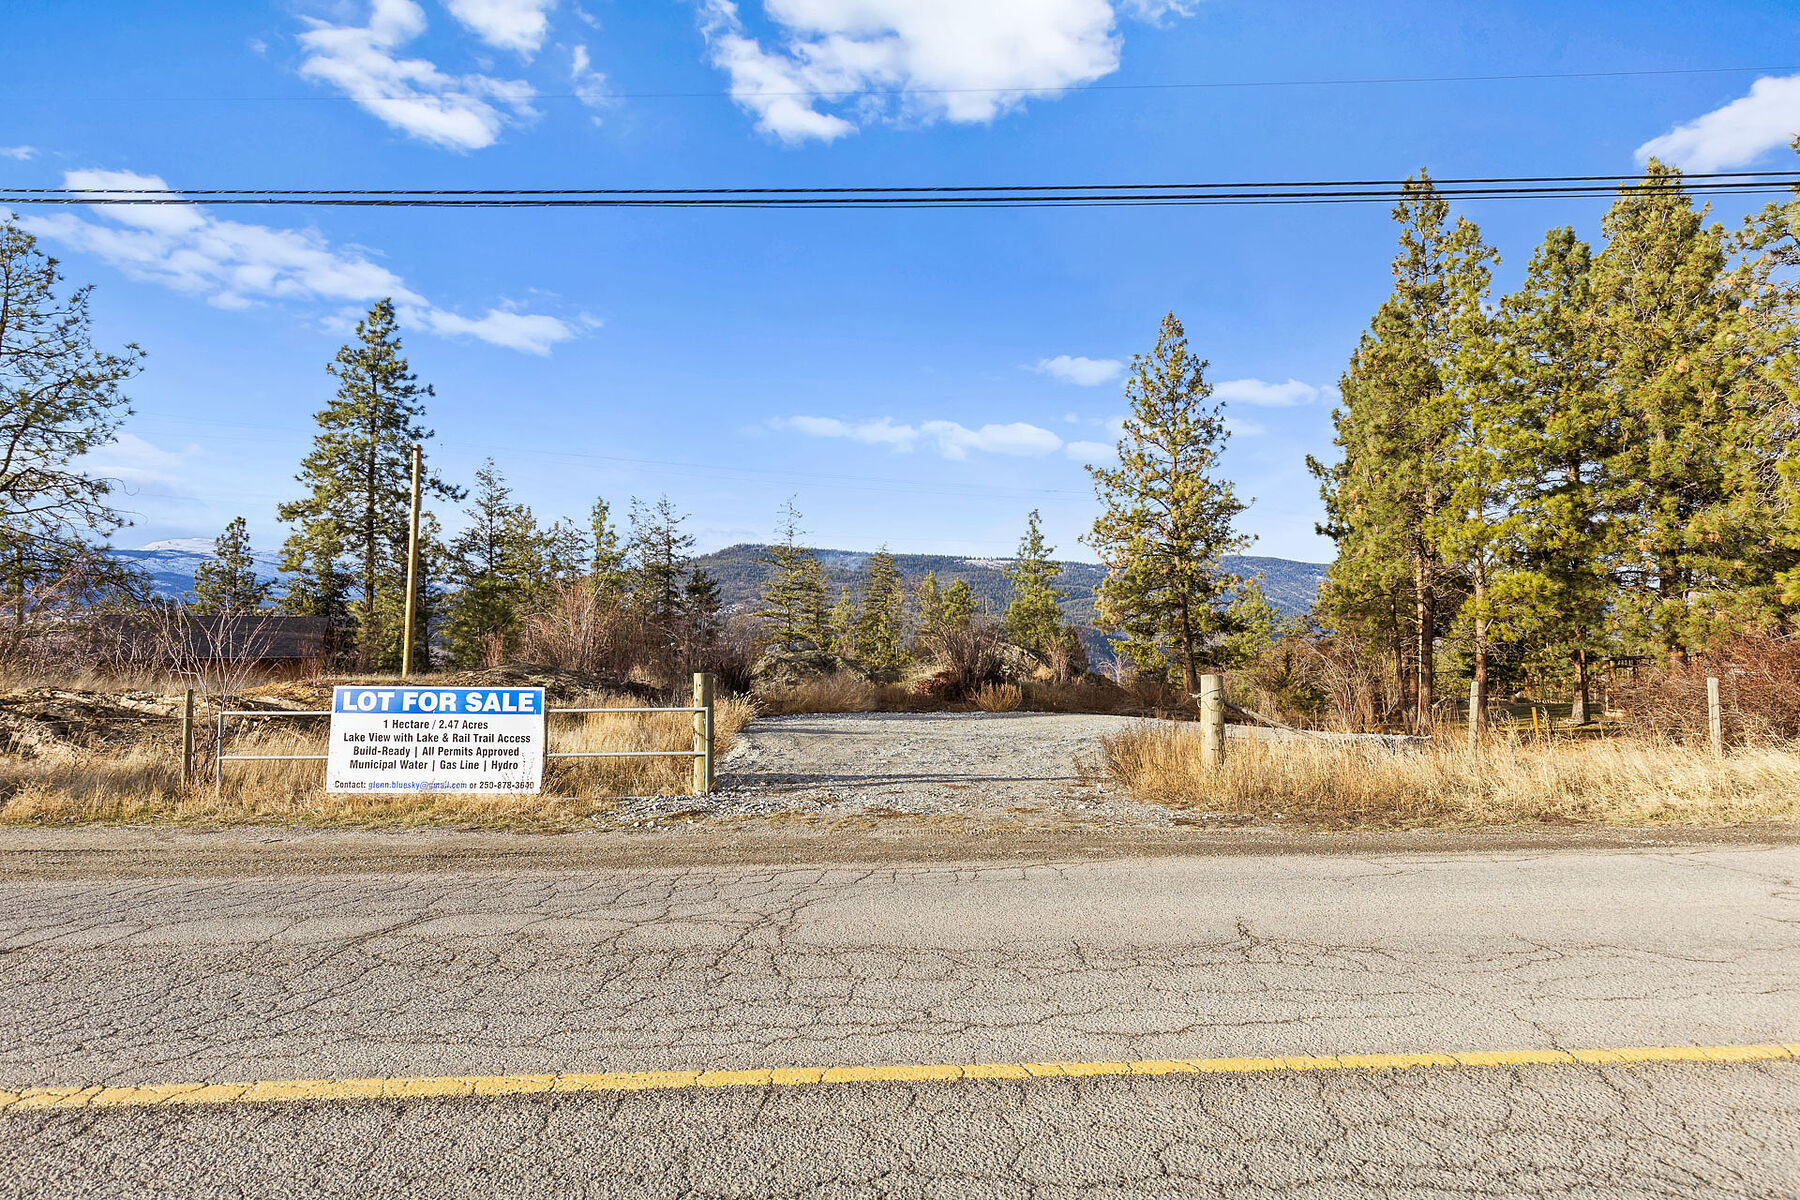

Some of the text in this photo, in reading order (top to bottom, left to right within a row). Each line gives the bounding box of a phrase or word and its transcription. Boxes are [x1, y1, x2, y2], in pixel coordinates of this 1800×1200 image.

[342, 691, 535, 712] LOT FOR SALE
[383, 720, 388, 729] 1
[392, 719, 430, 729] Hectare
[439, 720, 459, 729] 2.47
[462, 720, 489, 729] Acres
[343, 732, 531, 743] Lake View with Lake & Rail Trail Access
[353, 746, 411, 758] Build-Ready
[422, 746, 435, 756] All
[438, 746, 473, 757] Permits
[476, 746, 520, 758] Approved
[349, 760, 397, 771] Municipal
[400, 760, 428, 770] Water
[440, 760, 457, 770] Gas
[460, 760, 480, 770] Line
[491, 760, 519, 772] Hydro
[334, 780, 367, 789] Contact:
